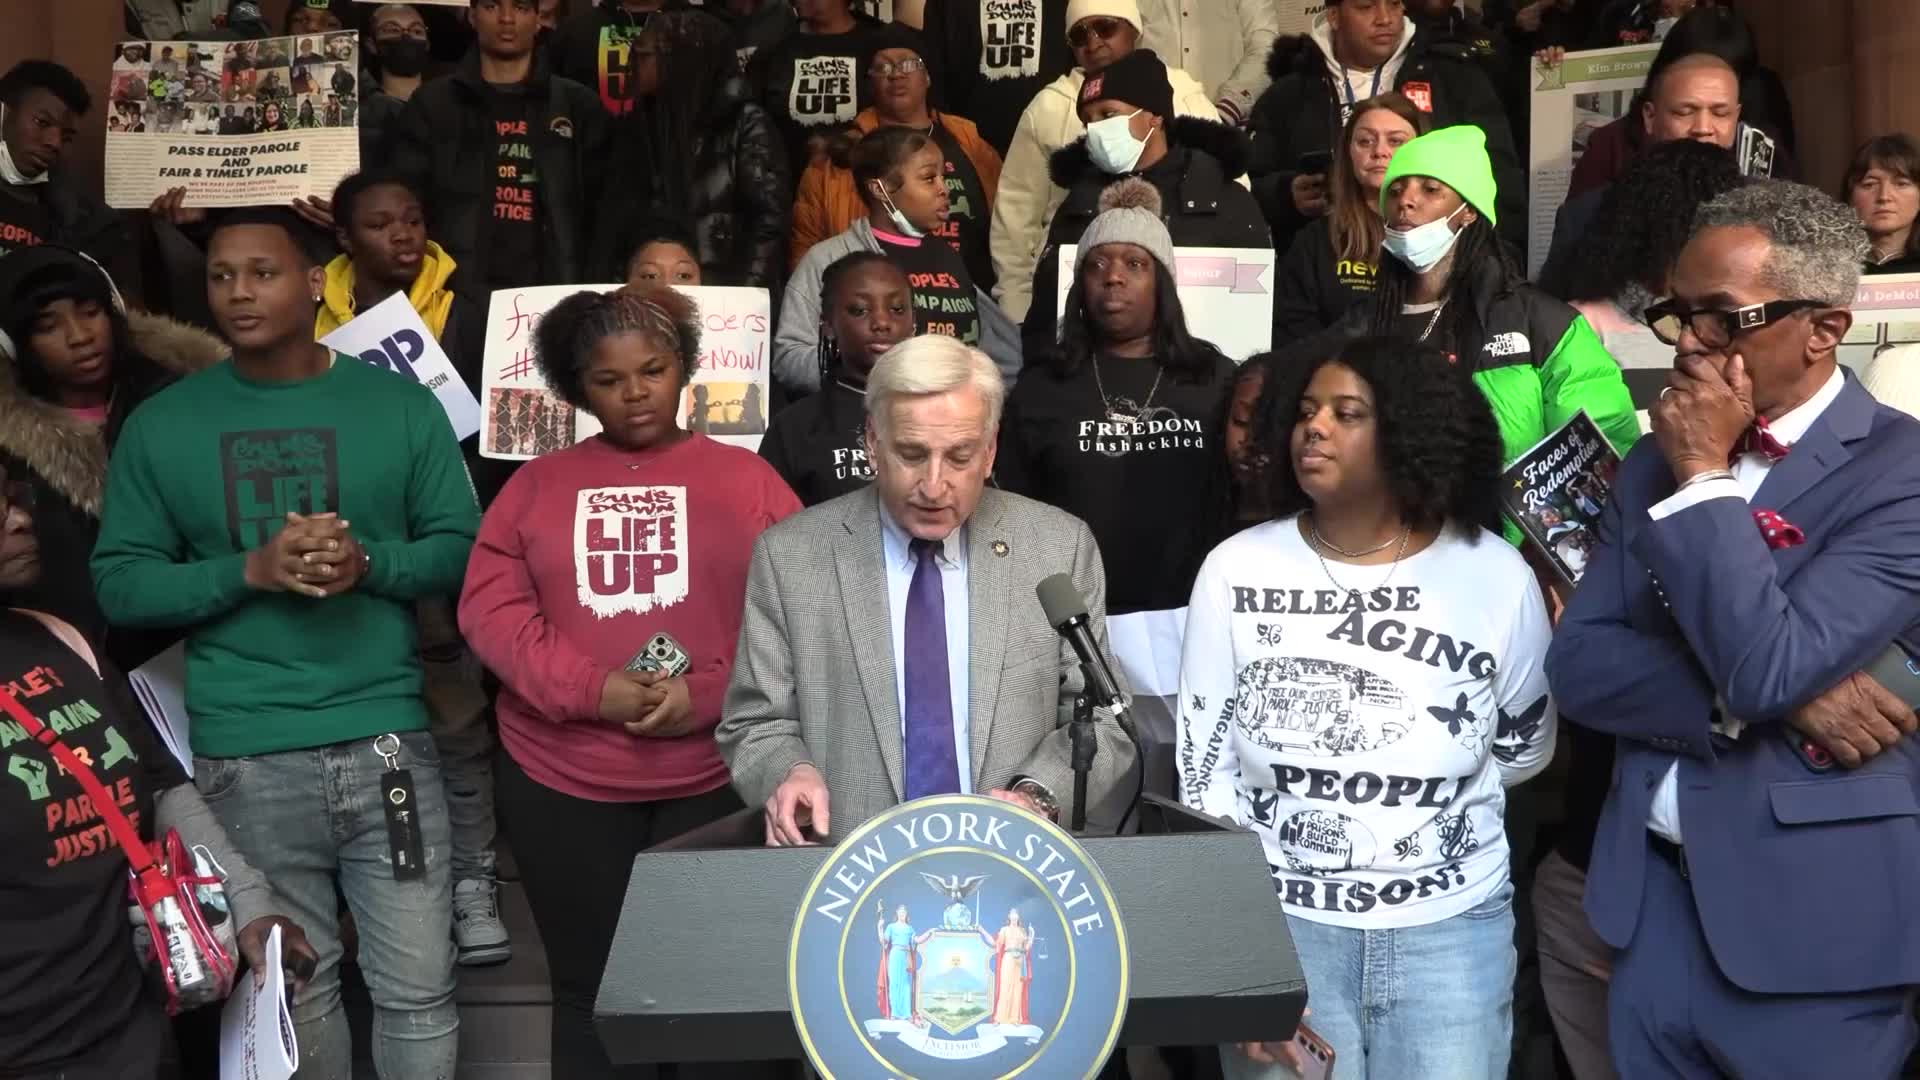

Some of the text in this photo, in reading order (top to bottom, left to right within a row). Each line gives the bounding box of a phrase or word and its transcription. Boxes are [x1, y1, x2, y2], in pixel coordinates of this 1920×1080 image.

[988, 12, 1036, 20] DOWN
[988, 22, 1035, 45] LIFE
[986, 46, 1035, 68] UP
[1588, 61, 1650, 74] Kim Brown
[798, 78, 849, 94] LIFE
[796, 95, 851, 114] UP
[168, 142, 301, 157] PASS ELDER PAROLE
[159, 163, 308, 178] FAIR & TIMELY PAROLE
[221, 158, 250, 167] AND
[498, 165, 517, 178] OR
[494, 203, 533, 221] TICE
[909, 273, 960, 289] OPLE'S
[927, 322, 956, 337] FOR
[1493, 333, 1513, 342] THE
[1491, 349, 1515, 357] FACE
[1079, 419, 1202, 437] FREEDOM
[1079, 436, 1203, 452] Unshackled
[1523, 426, 1584, 485] Faces of
[1523, 438, 1600, 510] Redemption
[588, 490, 676, 505] GUNS
[584, 502, 675, 515] DOWN
[586, 516, 676, 552] LIFE
[587, 553, 678, 595] UP
[1232, 586, 1421, 614] RELEASE
[1326, 611, 1497, 680] AGING
[1302, 700, 1342, 714] JUSTICE
[1276, 710, 1319, 731] NOW
[1196, 697, 1236, 792] ORGANIZING
[1310, 812, 1345, 830] CLOSE
[1300, 836, 1348, 857] COMMUNITY
[1306, 831, 1339, 846] BUILD
[816, 812, 1103, 936] NEW YORK STATE
